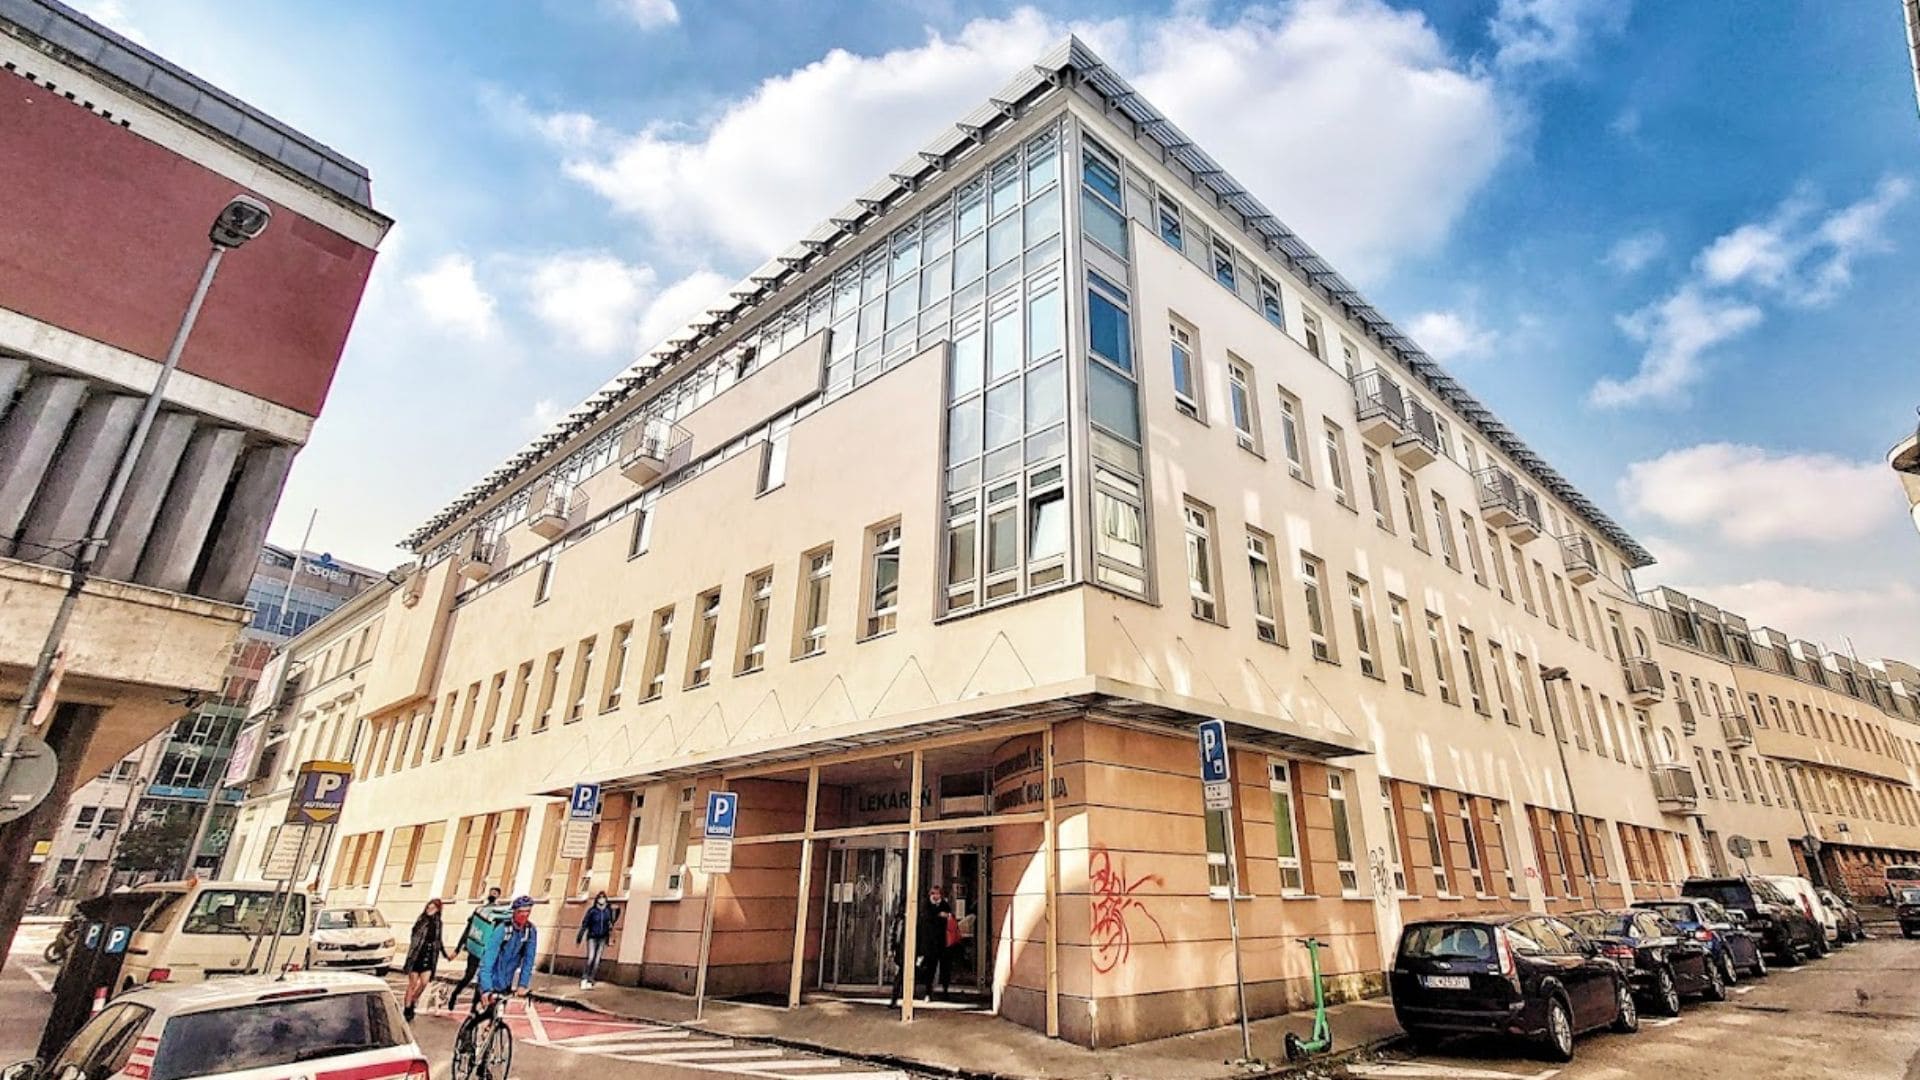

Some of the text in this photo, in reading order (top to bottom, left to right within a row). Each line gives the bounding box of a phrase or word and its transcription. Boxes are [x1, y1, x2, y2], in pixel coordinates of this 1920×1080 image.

[1204, 728, 1216, 763] P
[314, 773, 341, 801] P
[577, 787, 593, 809] P
[859, 784, 931, 812] LEKÁRŇ
[713, 797, 729, 823] P
[84, 925, 100, 945] P
[107, 930, 125, 951] P
